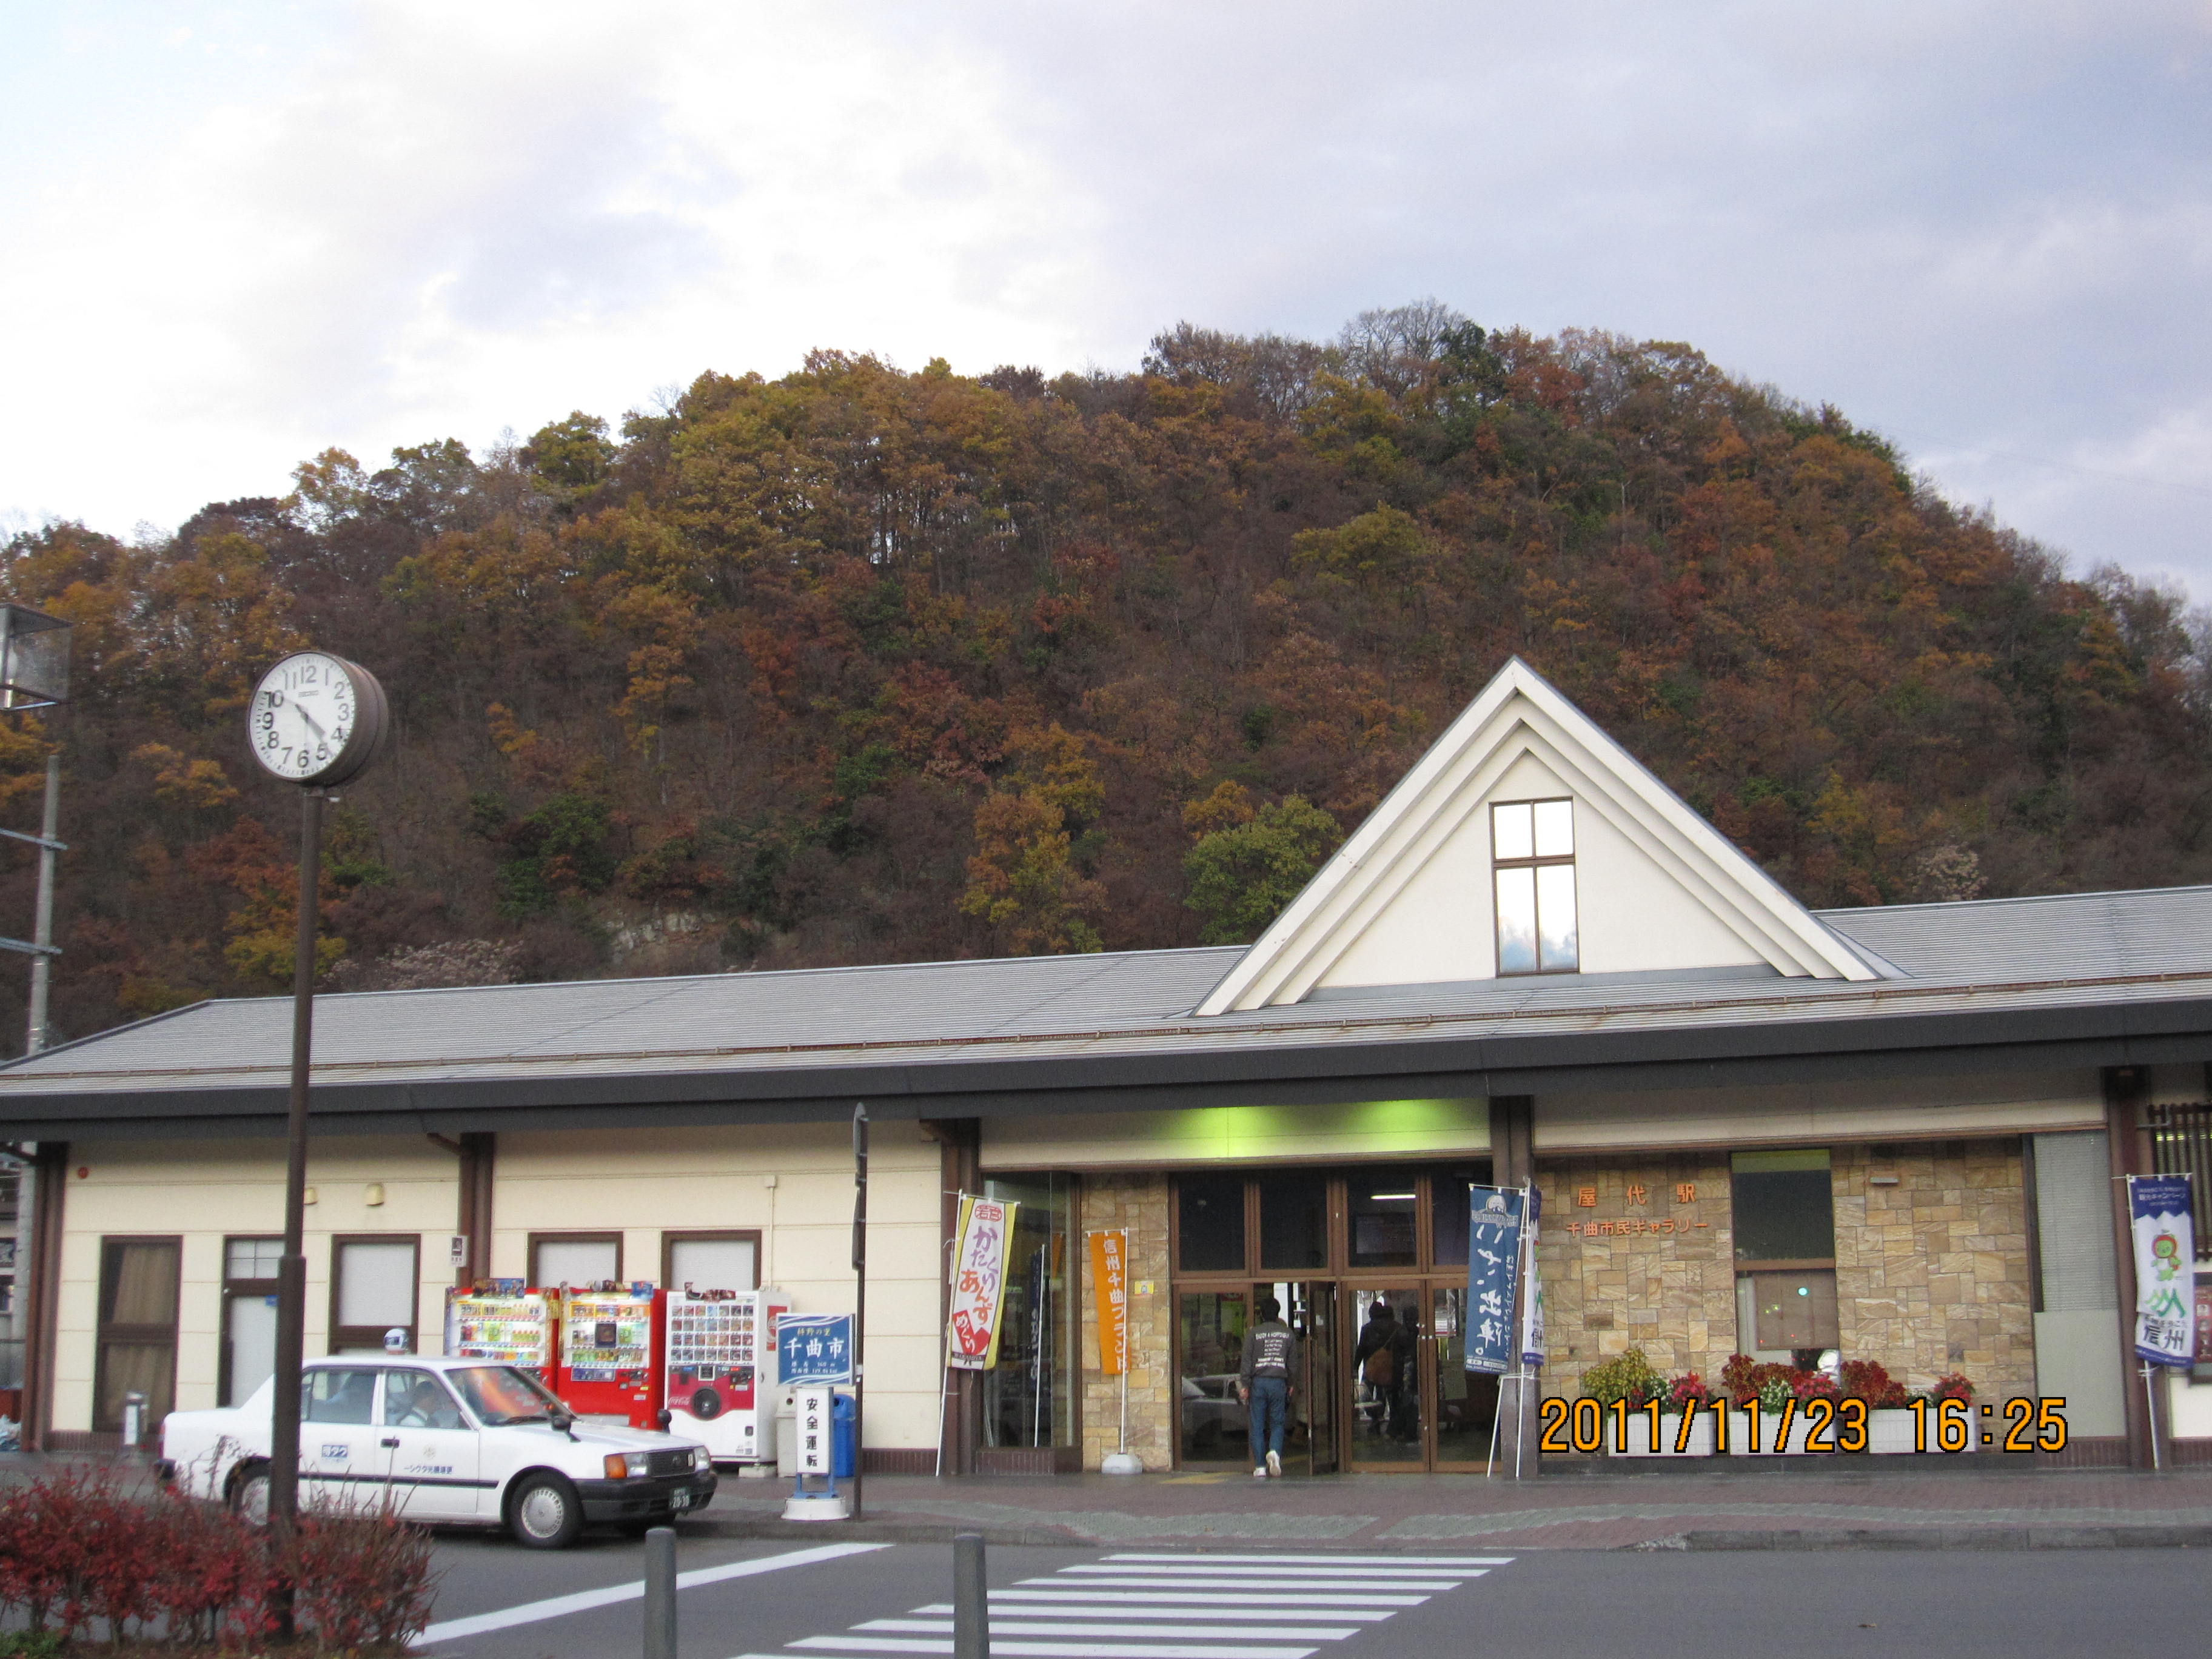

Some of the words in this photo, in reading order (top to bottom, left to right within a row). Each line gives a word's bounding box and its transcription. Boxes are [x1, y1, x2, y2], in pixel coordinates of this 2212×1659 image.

[284, 671, 297, 689] 11
[301, 666, 317, 684] 12
[324, 668, 329, 686] 1
[266, 689, 284, 708] 10
[333, 682, 346, 700] 2
[261, 711, 274, 730] 9
[338, 703, 349, 721] 3
[267, 731, 280, 749] 8
[330, 726, 343, 741] 4
[281, 746, 293, 765] 7
[297, 749, 309, 768] 6
[316, 743, 329, 760] 5
[1578, 1183, 1696, 1207] 屋代駅
[1566, 1218, 1708, 1238] 千曲市民ギャラリー
[970, 1225, 999, 1293] かたくり
[959, 1268, 993, 1326] あんず
[2143, 1324, 2185, 1351] 信州
[783, 1336, 845, 1359] 千曲市
[805, 1398, 818, 1468] 安全運転
